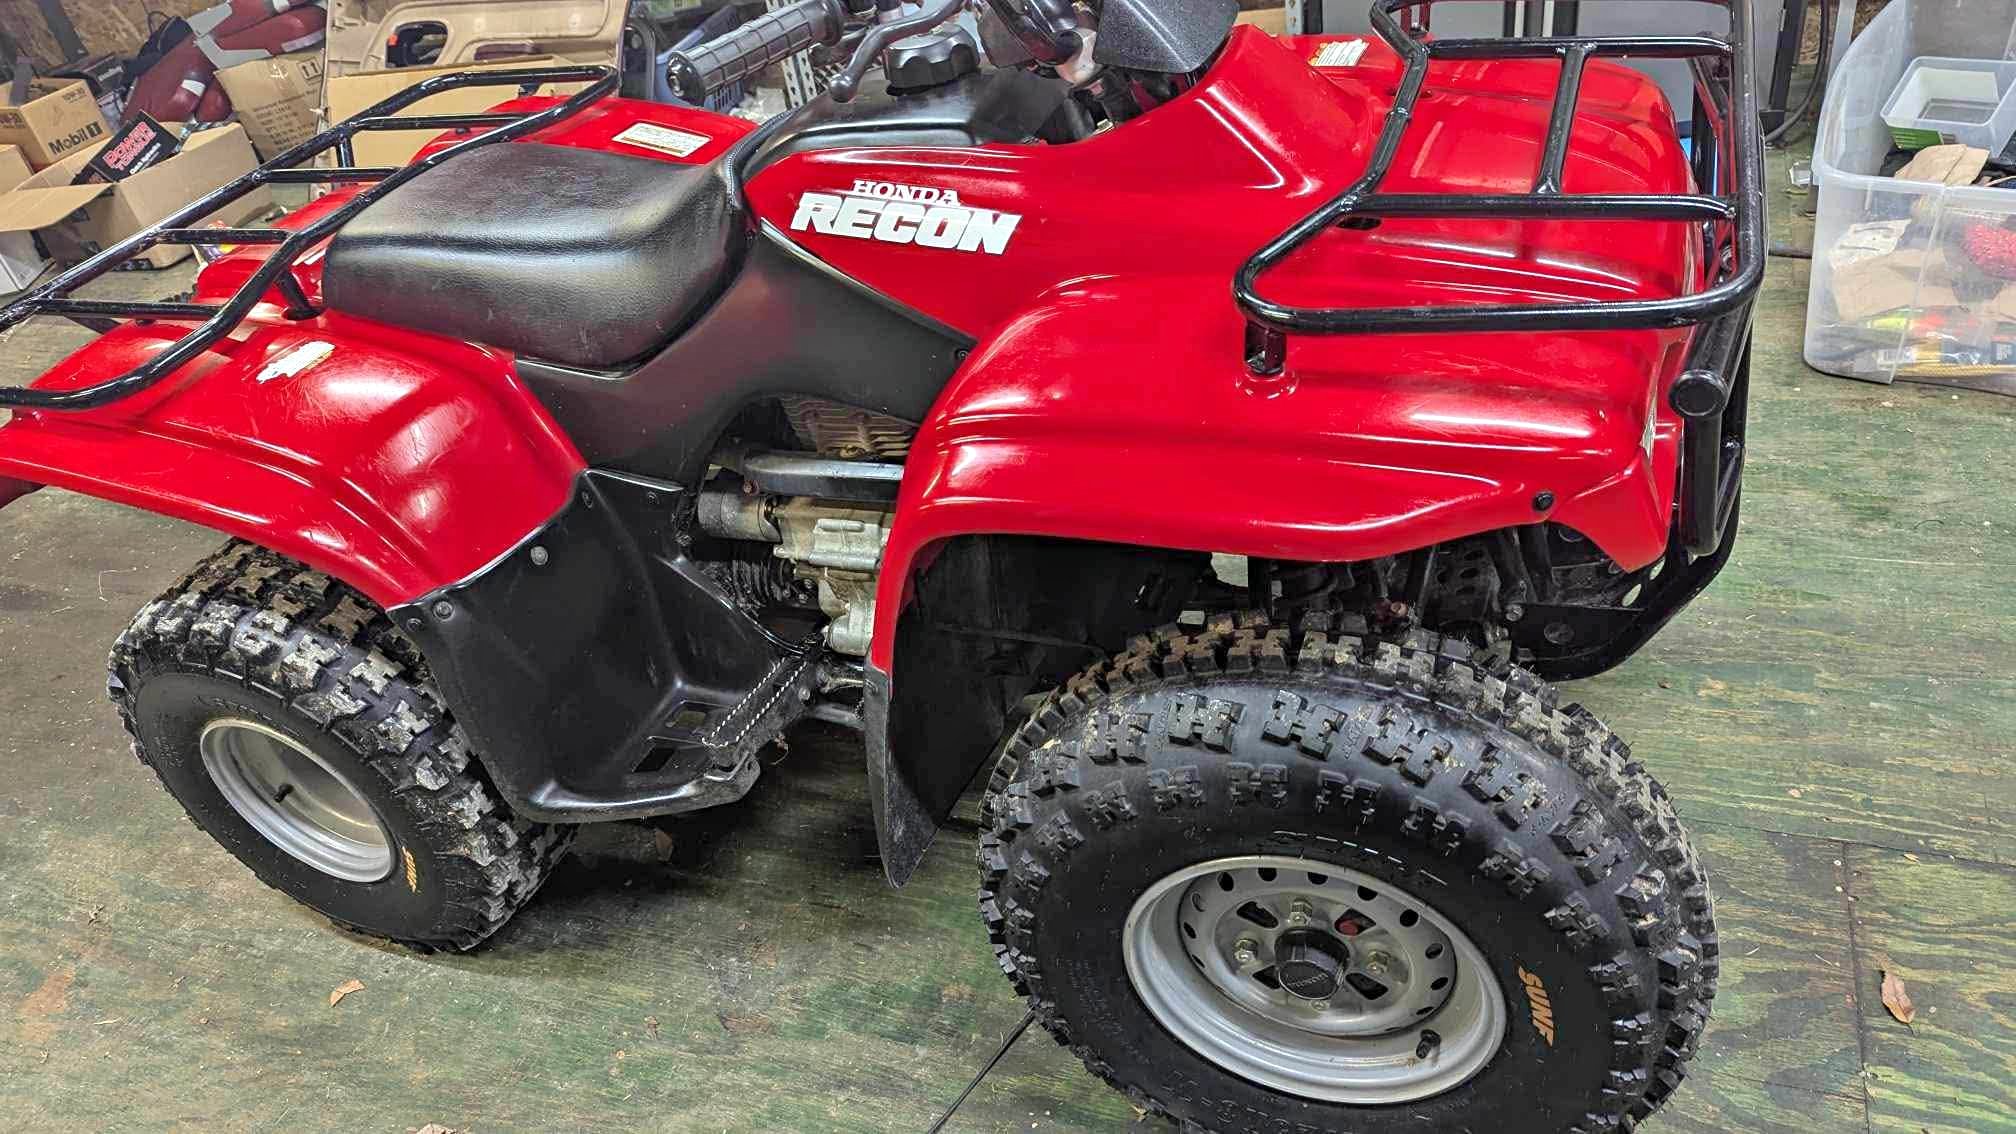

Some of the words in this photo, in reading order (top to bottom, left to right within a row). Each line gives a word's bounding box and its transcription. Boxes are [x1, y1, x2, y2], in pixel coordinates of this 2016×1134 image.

[48, 128, 88, 155] Mobil
[852, 179, 962, 206] HONDA
[790, 192, 1023, 256] RECON
[1518, 965, 1554, 1047] SUNF
